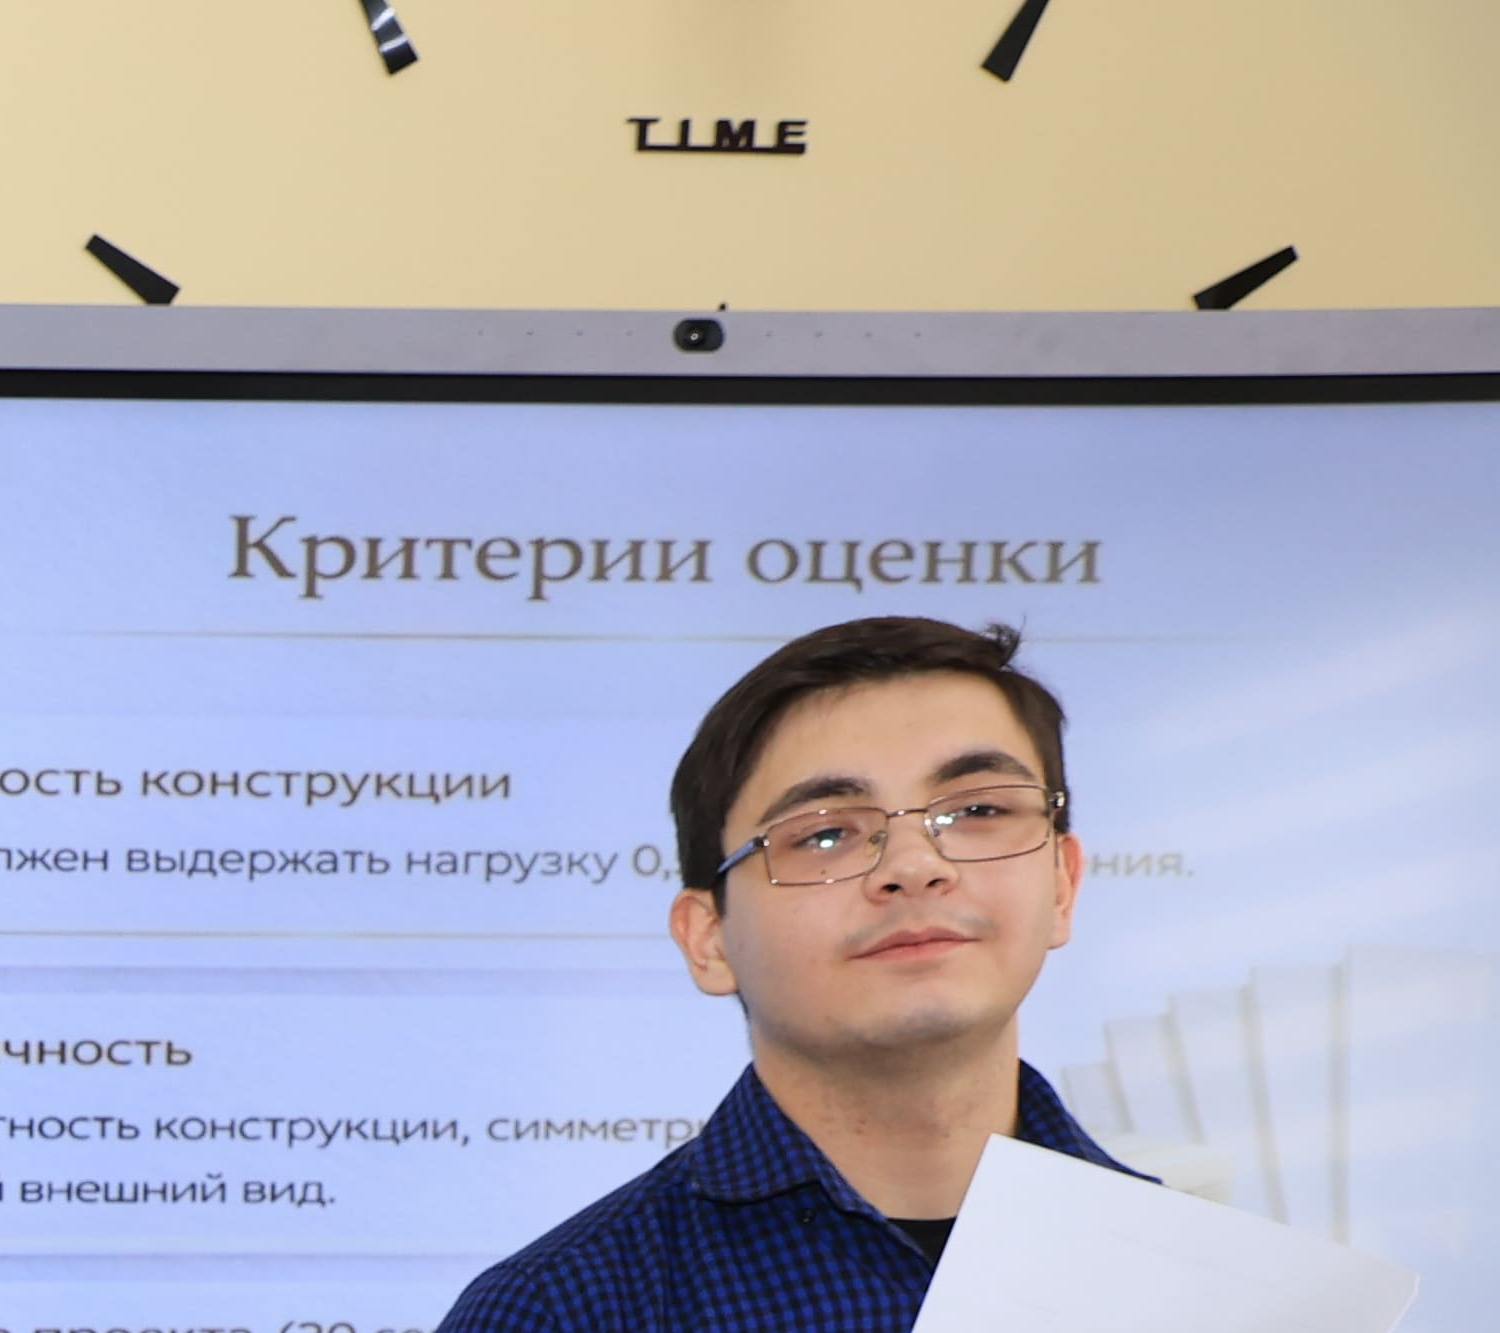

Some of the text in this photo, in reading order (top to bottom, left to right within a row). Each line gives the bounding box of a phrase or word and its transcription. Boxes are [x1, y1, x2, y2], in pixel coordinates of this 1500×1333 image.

[626, 117, 808, 156] TIME
[228, 515, 1103, 601] Критерии оценки
[140, 769, 512, 808] конструкции
[126, 848, 392, 882] выдержать
[406, 850, 619, 885] нагрузку
[633, 844, 682, 882] 0,
[1087, 852, 1196, 878] ния.
[154, 1116, 471, 1150] конструкции,
[486, 1117, 706, 1148] симметр
[20, 1173, 227, 1204] внешний
[243, 1181, 336, 1208] вид.
